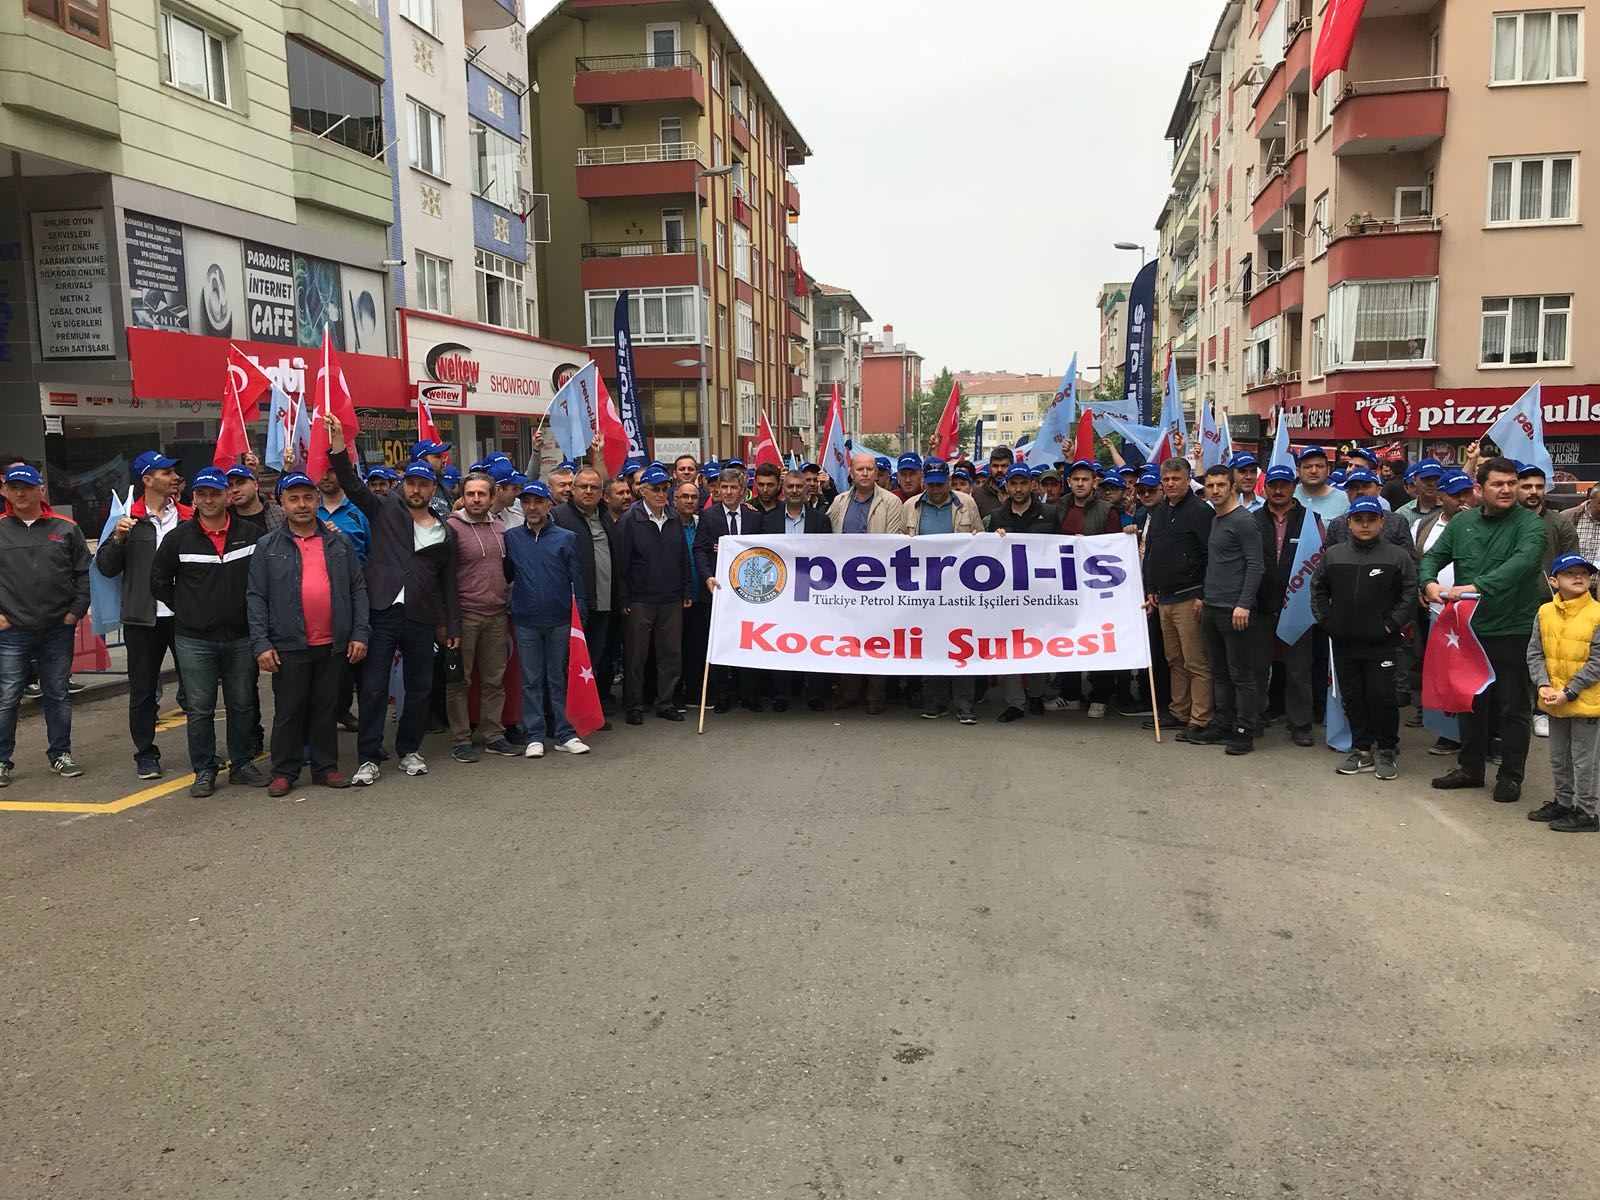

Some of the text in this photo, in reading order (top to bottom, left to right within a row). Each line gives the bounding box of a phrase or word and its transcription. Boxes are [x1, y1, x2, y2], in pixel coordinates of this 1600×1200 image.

[72, 217, 94, 226] OYUN
[72, 242, 100, 251] ONLINE
[40, 256, 104, 266] KARAHAN ONLINE
[247, 250, 290, 272] PARADİSE
[40, 268, 106, 278] SILKROAD ONLINE
[249, 273, 292, 300] İNTERNET
[50, 306, 103, 316] CABAL ONLINE
[52, 320, 62, 328] VE
[252, 304, 294, 338] CAFE
[56, 332, 90, 340] PREMIUM
[71, 344, 110, 354] SATIŞLARI
[435, 353, 480, 384] weltew
[490, 374, 540, 397] SHOWROOM
[430, 390, 459, 400] weltew
[1356, 396, 1396, 410] pizza
[1540, 395, 1600, 423] ulls
[1372, 424, 1405, 436] bulls
[794, 544, 1127, 601] petrol-iş
[764, 591, 777, 601] 1950
[812, 594, 1079, 609] Türkiye Petrol Kimya Lastik İşçileri Sendikası
[739, 620, 923, 660] Kocaeli
[948, 622, 1117, 668] Şubesi
